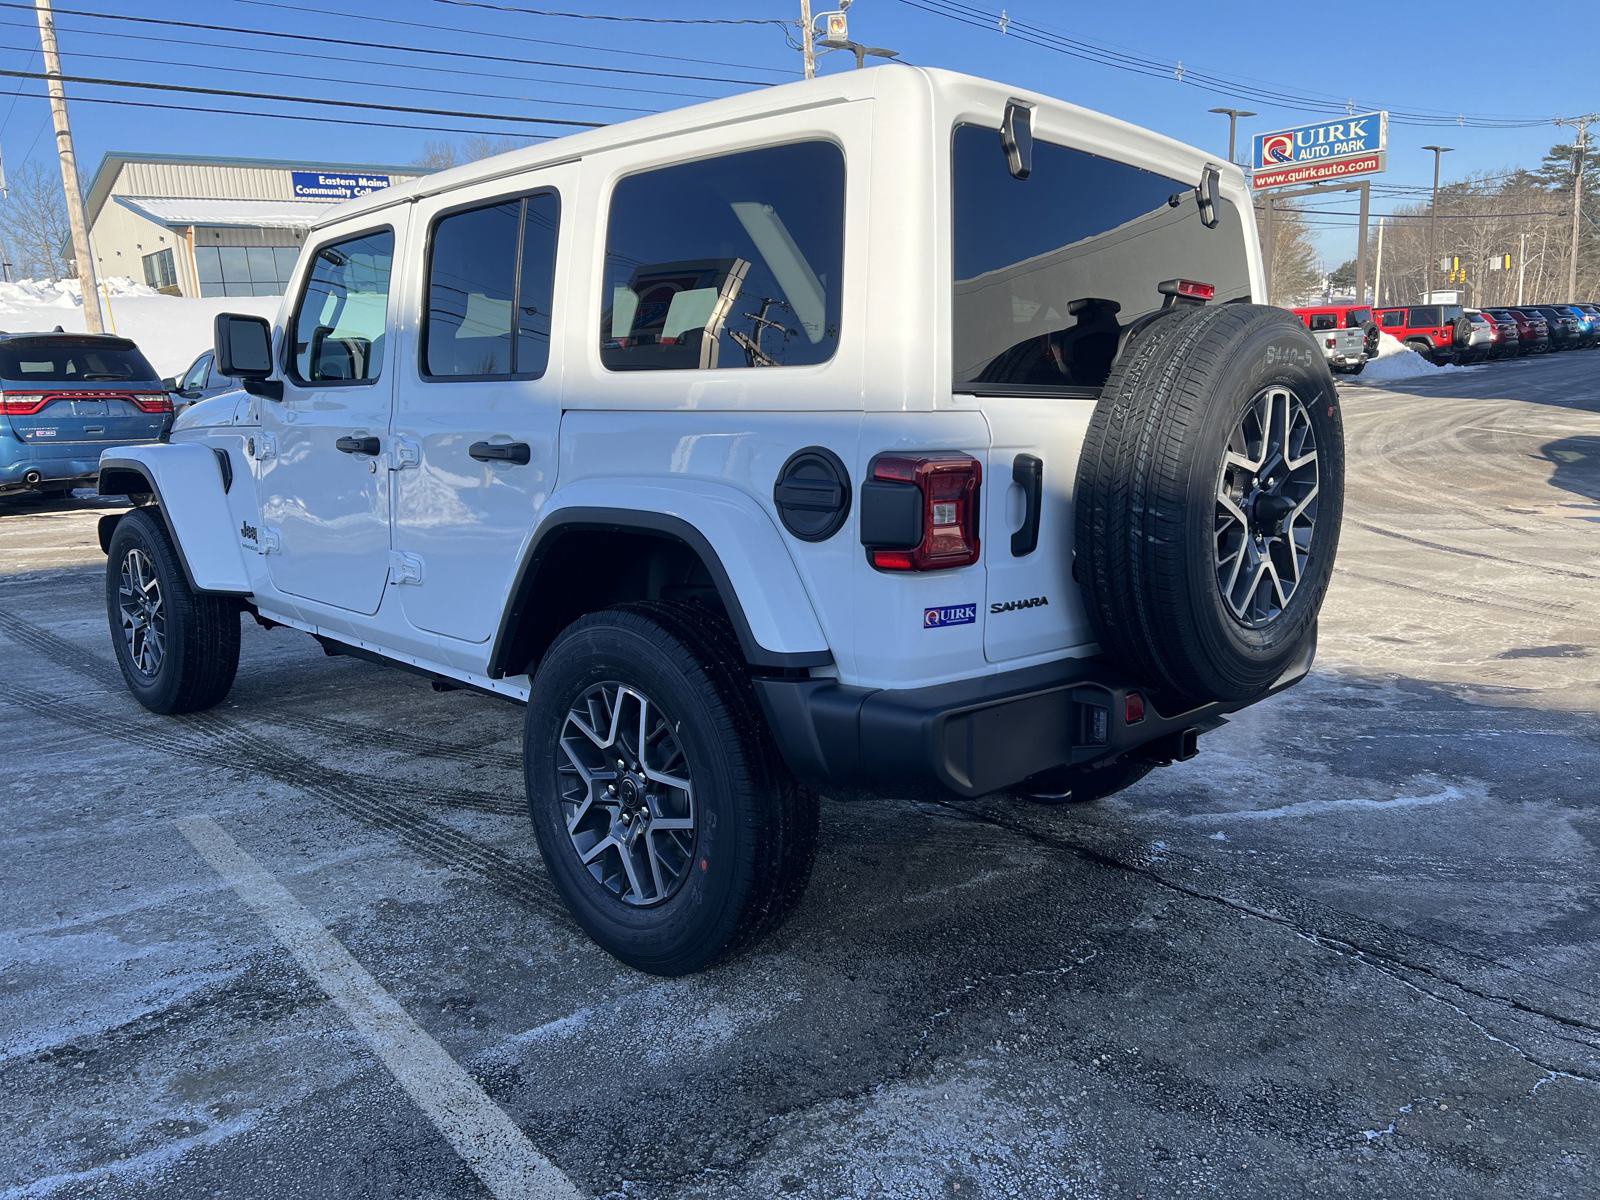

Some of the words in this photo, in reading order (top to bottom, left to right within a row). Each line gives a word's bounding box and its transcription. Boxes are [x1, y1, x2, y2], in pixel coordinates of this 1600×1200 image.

[1263, 119, 1368, 163] QUIRK
[1299, 146, 1330, 160] AUTO
[1334, 138, 1366, 153] PARK
[318, 175, 356, 186] Eastern
[359, 177, 388, 188] Maine
[1256, 159, 1376, 186] www.quirkauto.com
[295, 185, 351, 198] Community
[353, 187, 372, 197] Coll
[990, 596, 1049, 614] SAHARA
[925, 606, 975, 626] QUIRK
